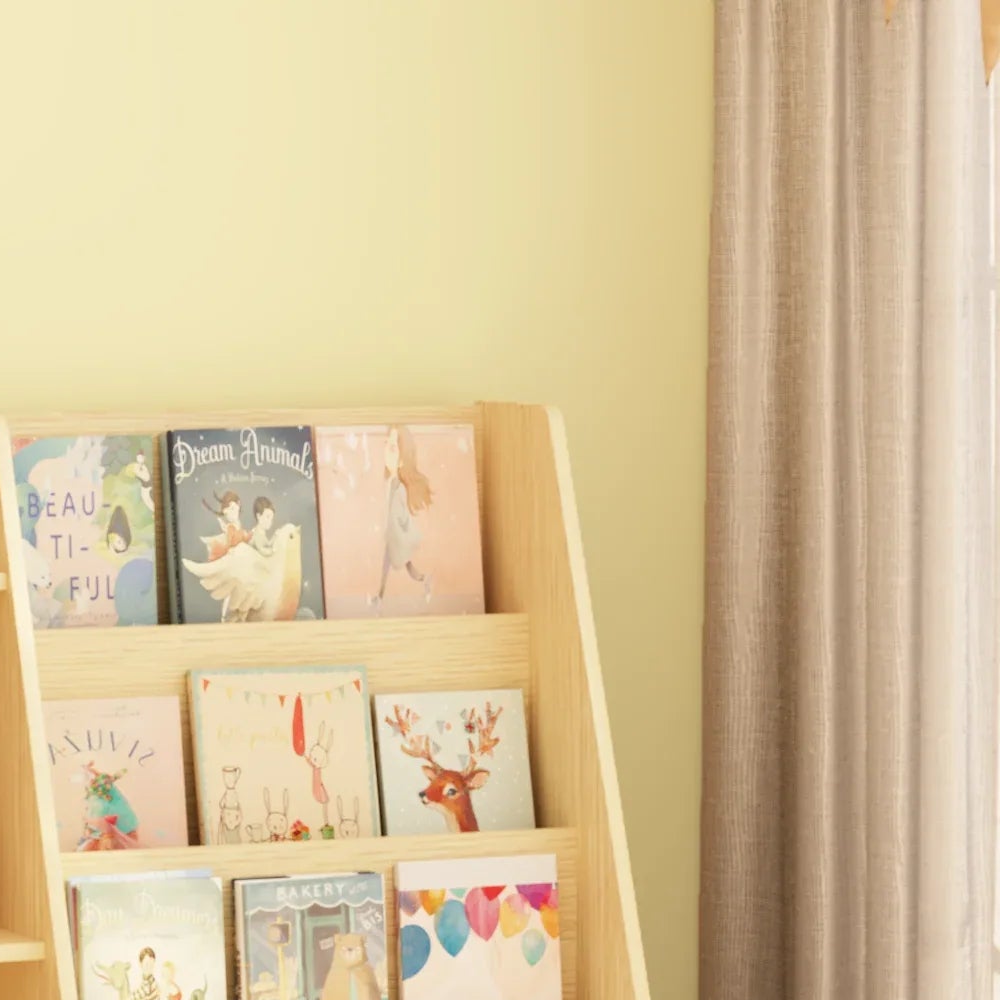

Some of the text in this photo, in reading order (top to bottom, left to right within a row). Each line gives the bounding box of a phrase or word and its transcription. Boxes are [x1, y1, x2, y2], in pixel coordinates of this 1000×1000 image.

[172, 427, 313, 485] Dream Animals
[50, 534, 88, 559] TI-
[69, 574, 114, 601] FUL
[276, 882, 345, 901] BAKERY
